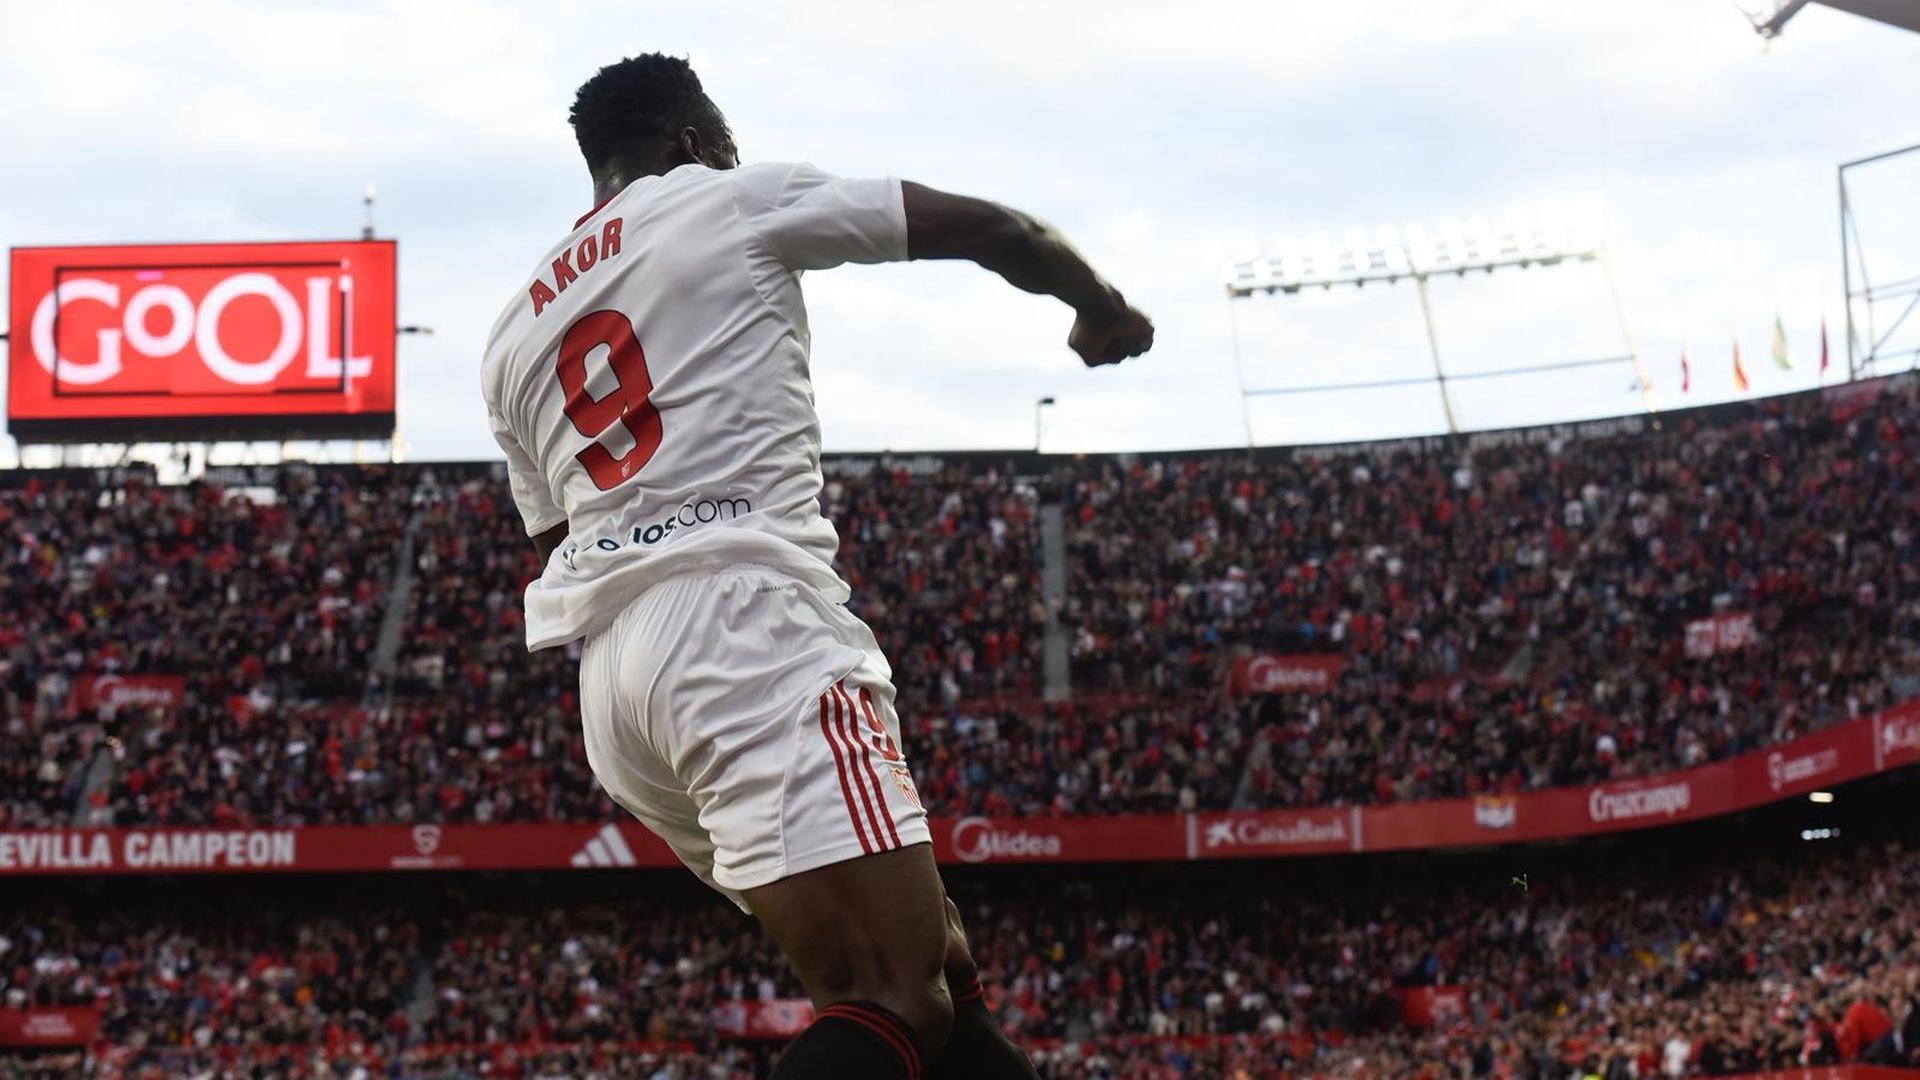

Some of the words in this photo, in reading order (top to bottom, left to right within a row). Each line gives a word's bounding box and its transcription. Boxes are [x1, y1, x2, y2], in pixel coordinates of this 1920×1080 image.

[529, 217, 623, 317] AKOR
[556, 310, 663, 491] 9
[124, 831, 295, 866] CAMPEON
[968, 827, 1061, 861] Midea
